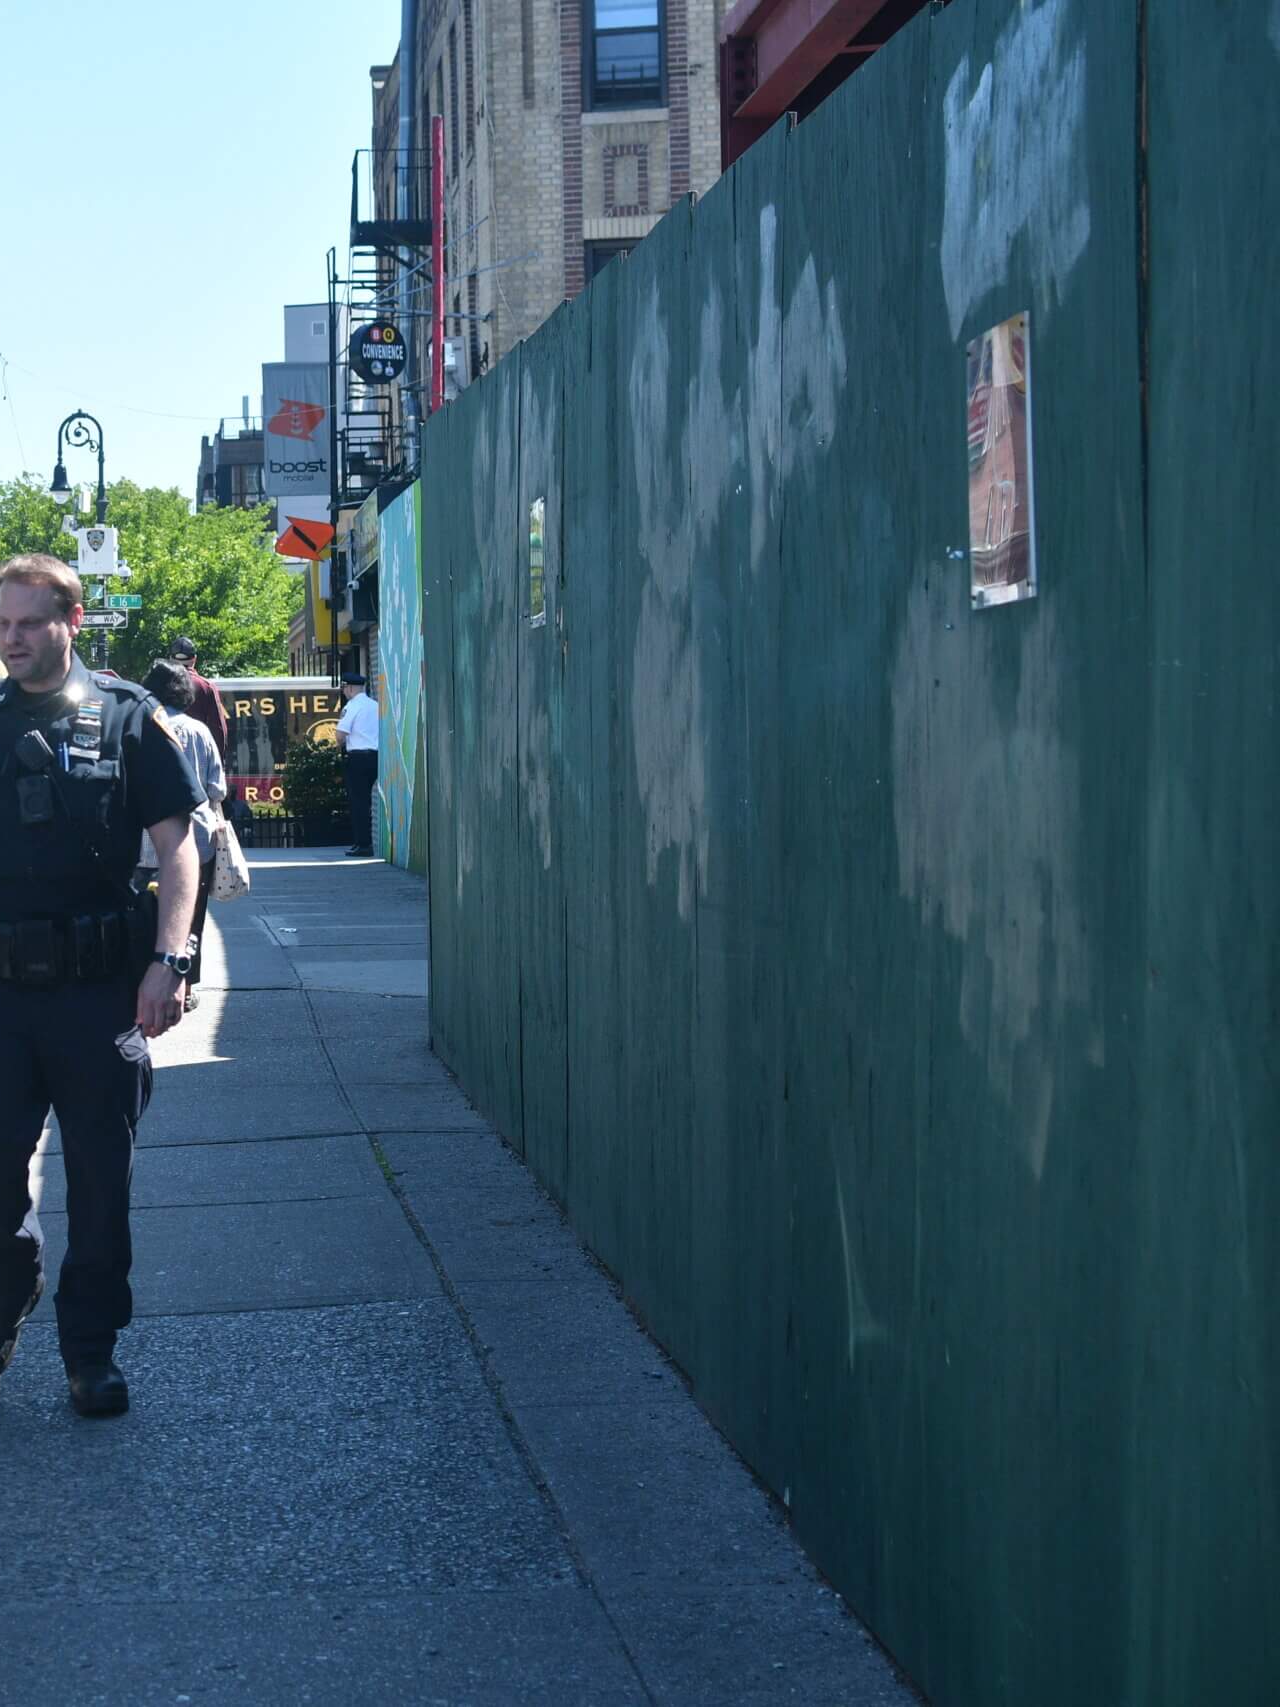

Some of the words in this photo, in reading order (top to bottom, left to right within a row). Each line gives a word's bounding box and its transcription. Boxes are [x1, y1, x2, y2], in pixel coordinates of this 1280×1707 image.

[385, 330, 392, 341] Q
[362, 344, 404, 360] CONVENIENCE
[269, 458, 327, 473] boost
[283, 474, 314, 482] mobile
[110, 597, 116, 606] E
[119, 597, 128, 607] 16
[104, 615, 120, 623] WAY
